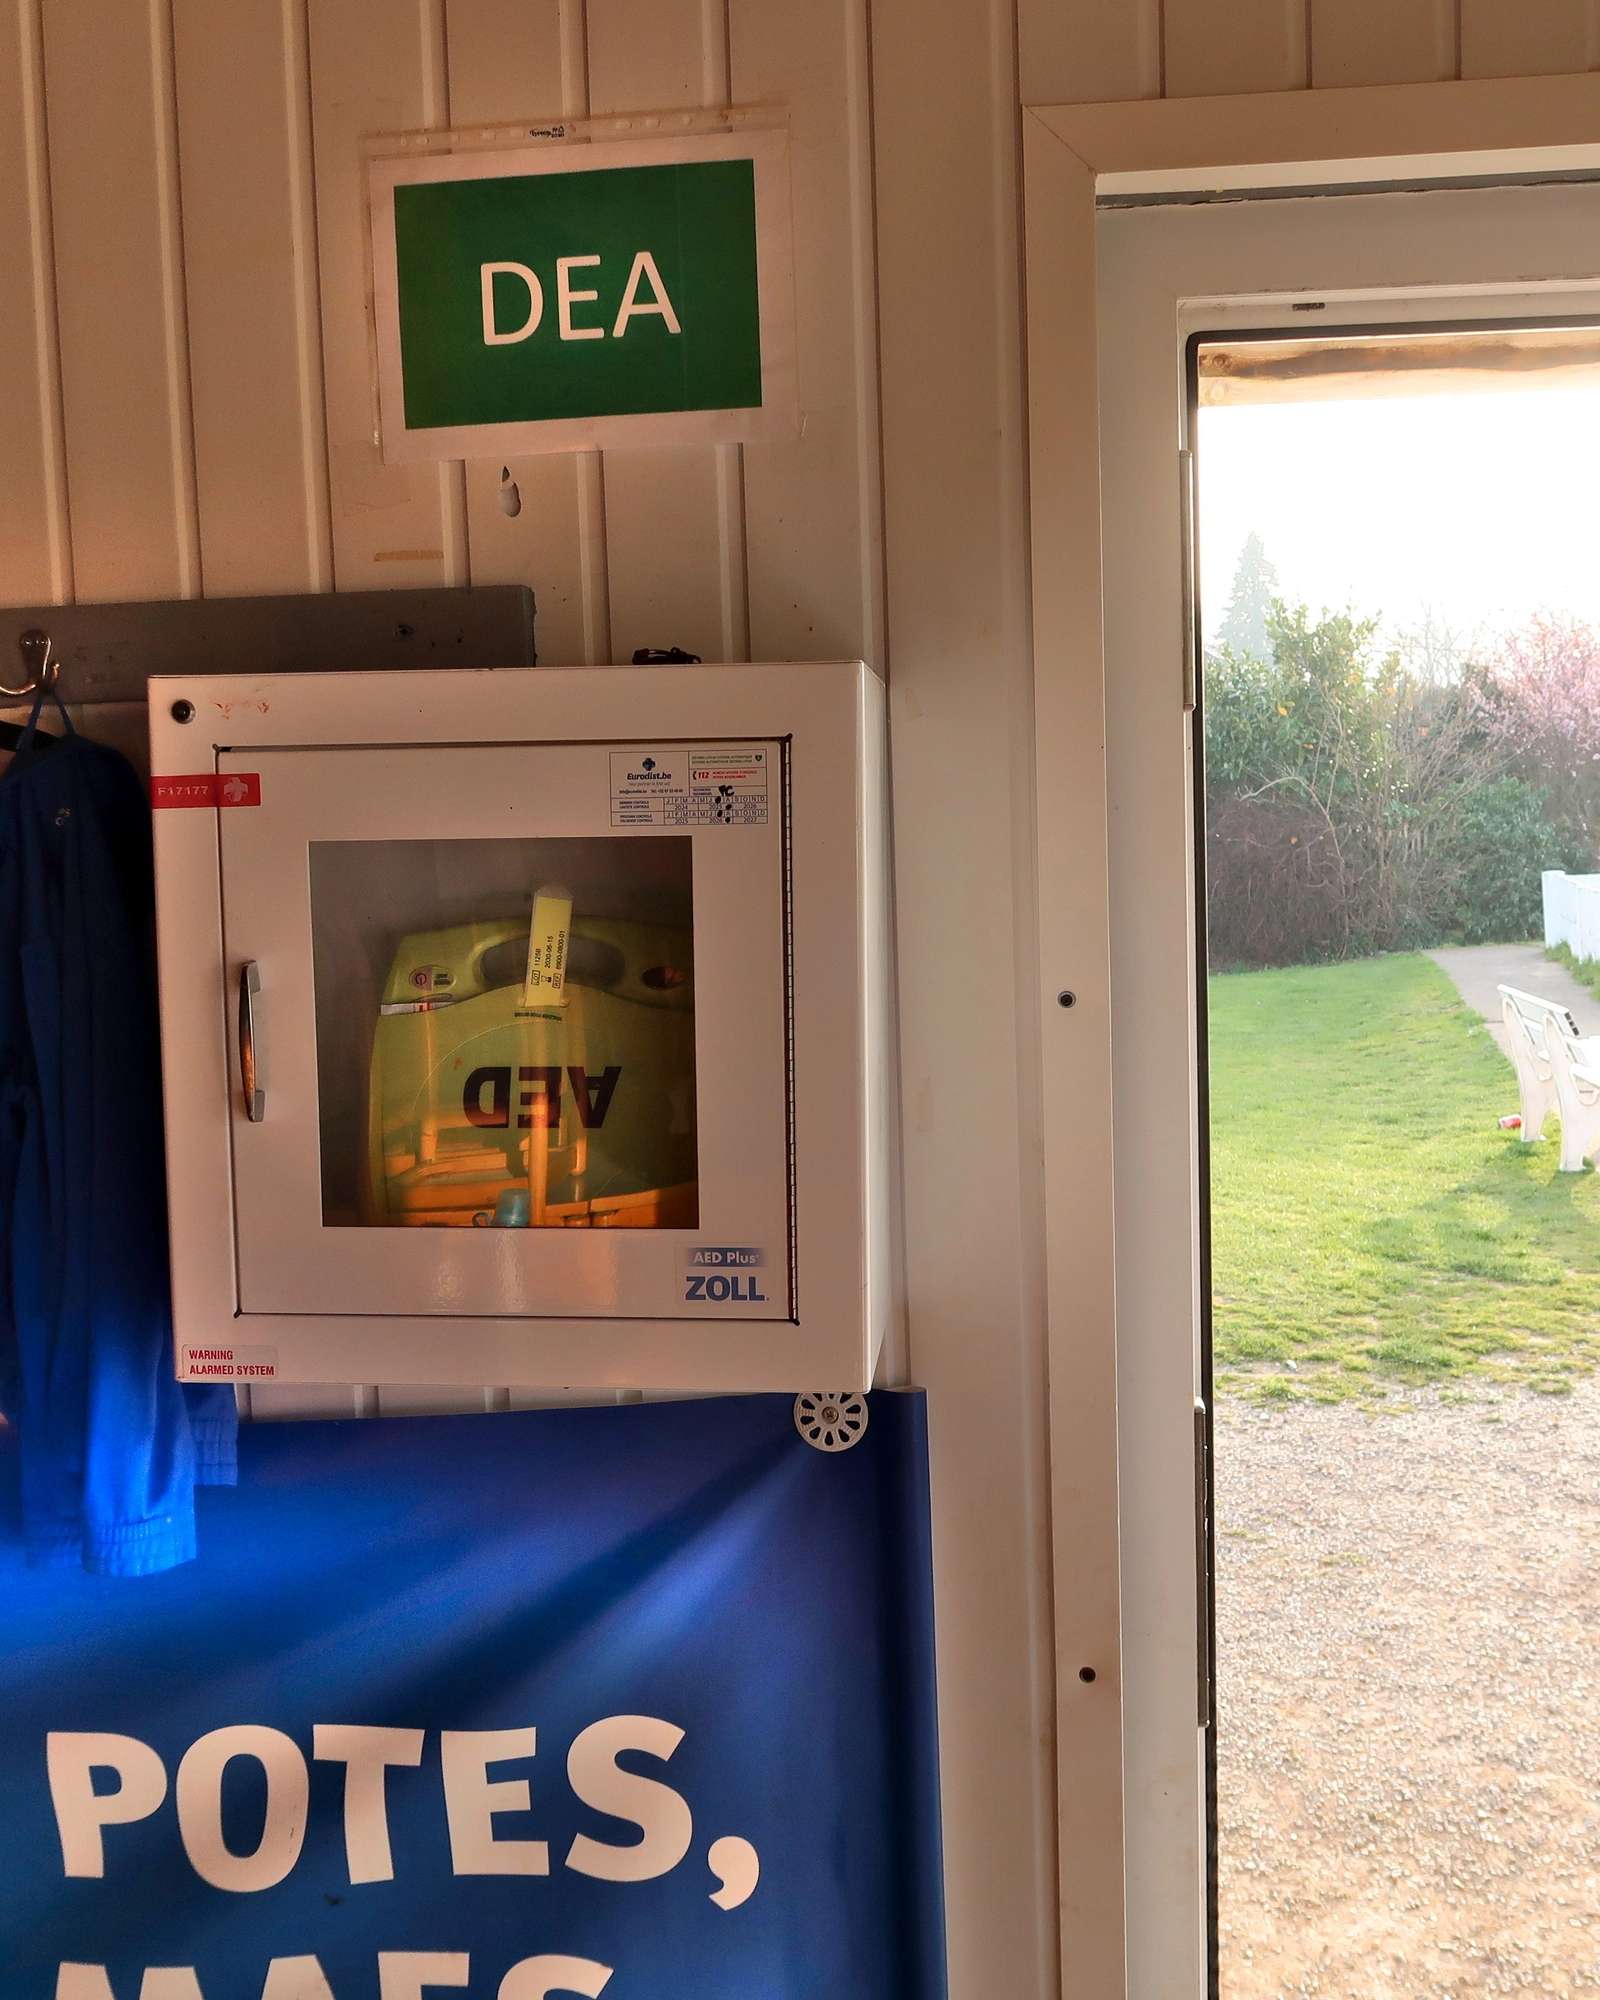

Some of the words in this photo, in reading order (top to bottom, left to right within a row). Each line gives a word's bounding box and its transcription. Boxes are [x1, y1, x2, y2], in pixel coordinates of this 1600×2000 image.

[480, 251, 682, 346] DEA
[627, 771, 672, 781] Eurodist.be
[158, 785, 209, 796] F17177
[463, 1066, 622, 1128] AED
[694, 1251, 722, 1264] AED
[685, 1275, 766, 1301] ZOLL
[189, 1350, 233, 1360] WARNING
[189, 1365, 234, 1375] ALARMED
[236, 1365, 275, 1376] SYSTEM
[46, 1714, 761, 1912] POTES,
